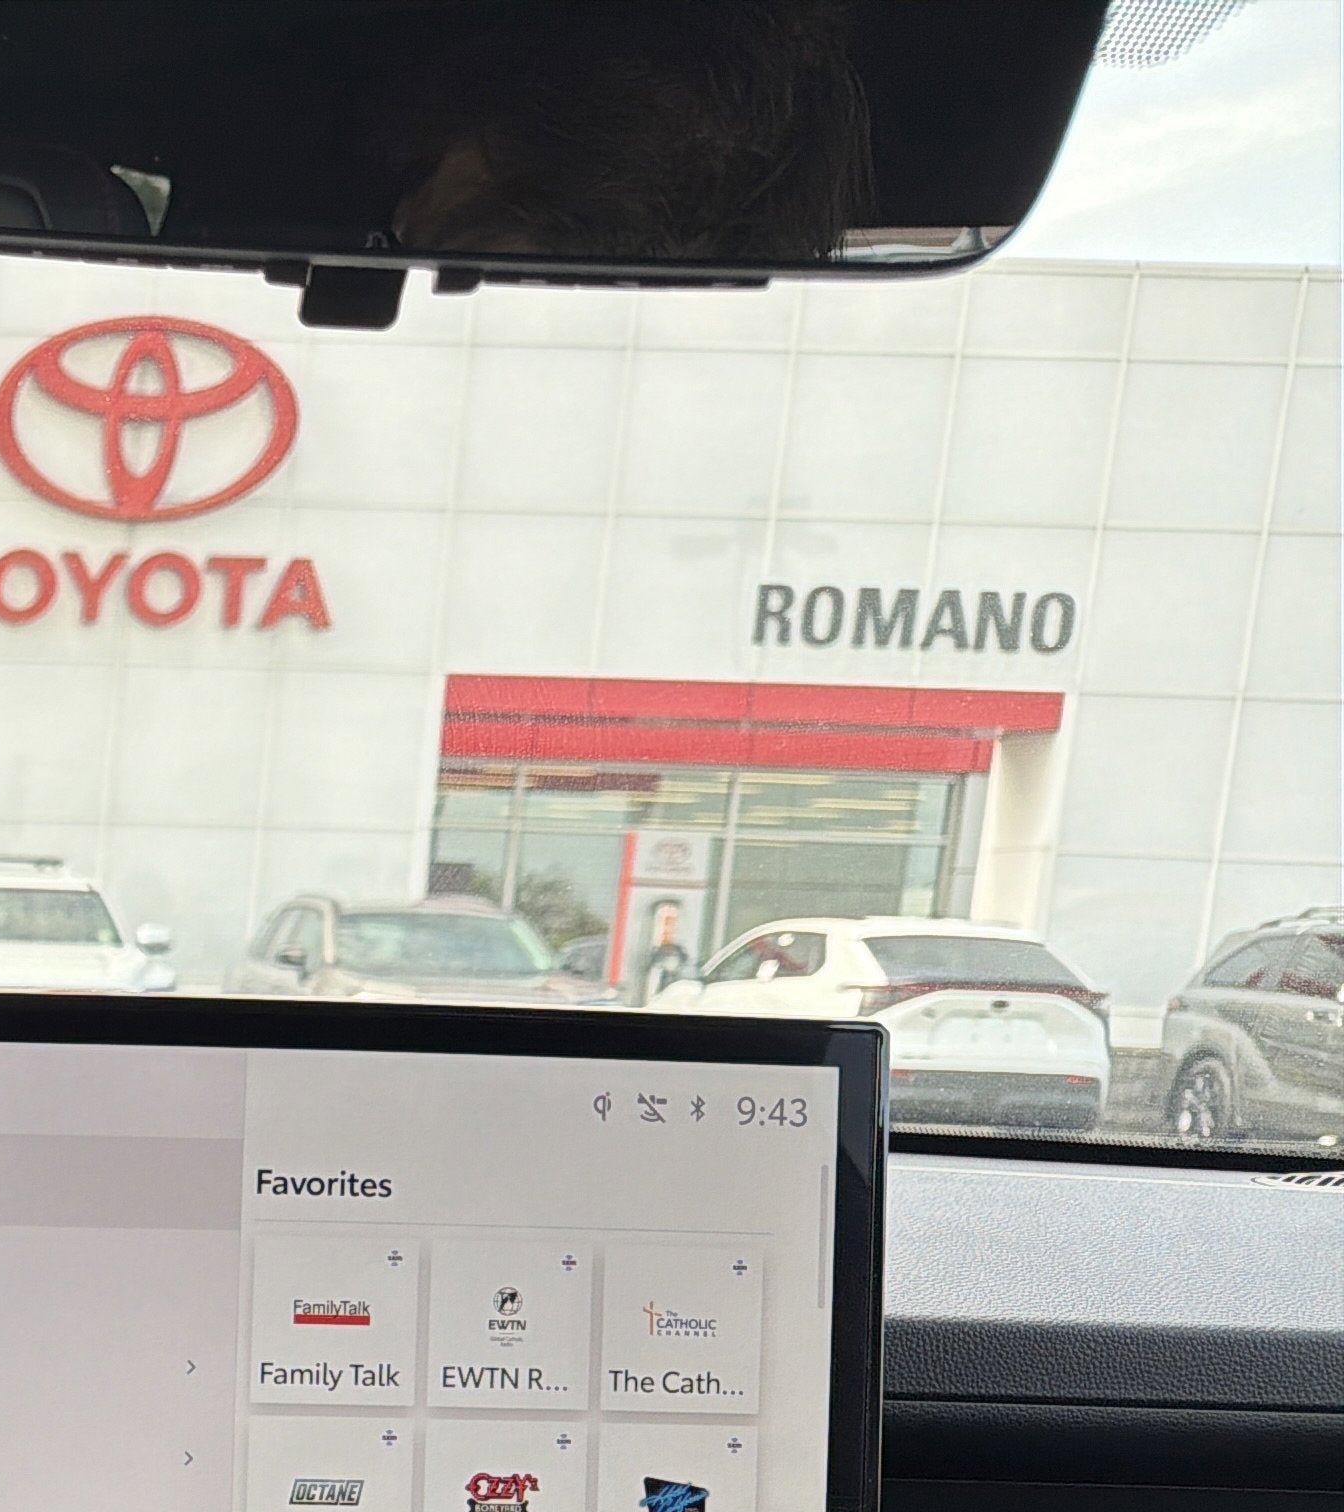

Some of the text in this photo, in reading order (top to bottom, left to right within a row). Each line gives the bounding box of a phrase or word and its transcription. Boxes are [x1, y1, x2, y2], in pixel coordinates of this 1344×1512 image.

[751, 583, 1076, 654] ROMANO
[737, 1096, 809, 1128] 9:43
[256, 1169, 392, 1199] Favorites
[488, 1319, 527, 1331] EWTN
[656, 1318, 717, 1330] CATHOLIC
[656, 1329, 717, 1338] CHANNEL
[259, 1362, 400, 1391] Family Talk
[443, 1366, 520, 1390] EWTN
[609, 1371, 744, 1397] The Cath...
[295, 1482, 359, 1502] OCTANE
